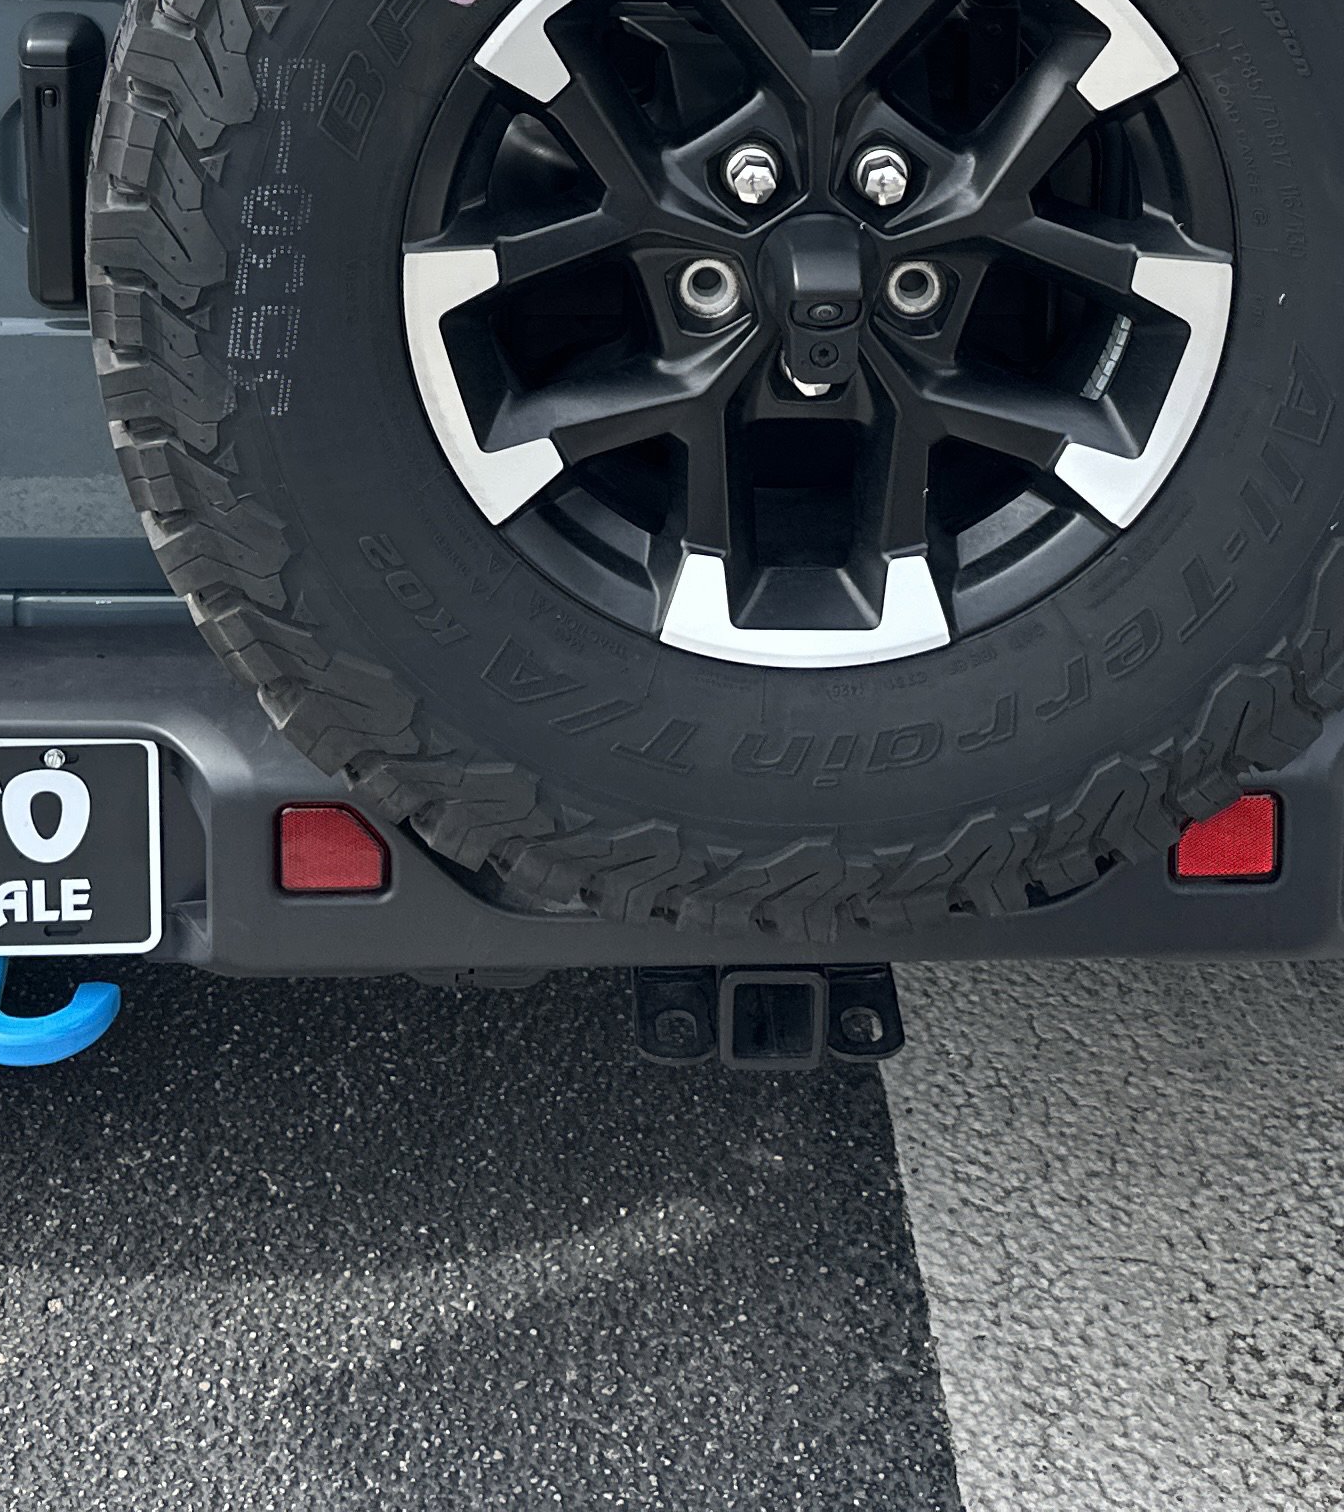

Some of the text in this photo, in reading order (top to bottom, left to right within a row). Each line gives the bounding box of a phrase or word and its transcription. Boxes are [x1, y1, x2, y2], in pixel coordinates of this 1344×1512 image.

[358, 533, 470, 646] KO2
[732, 341, 1335, 786] All-Terrain
[480, 634, 700, 775] T/A
